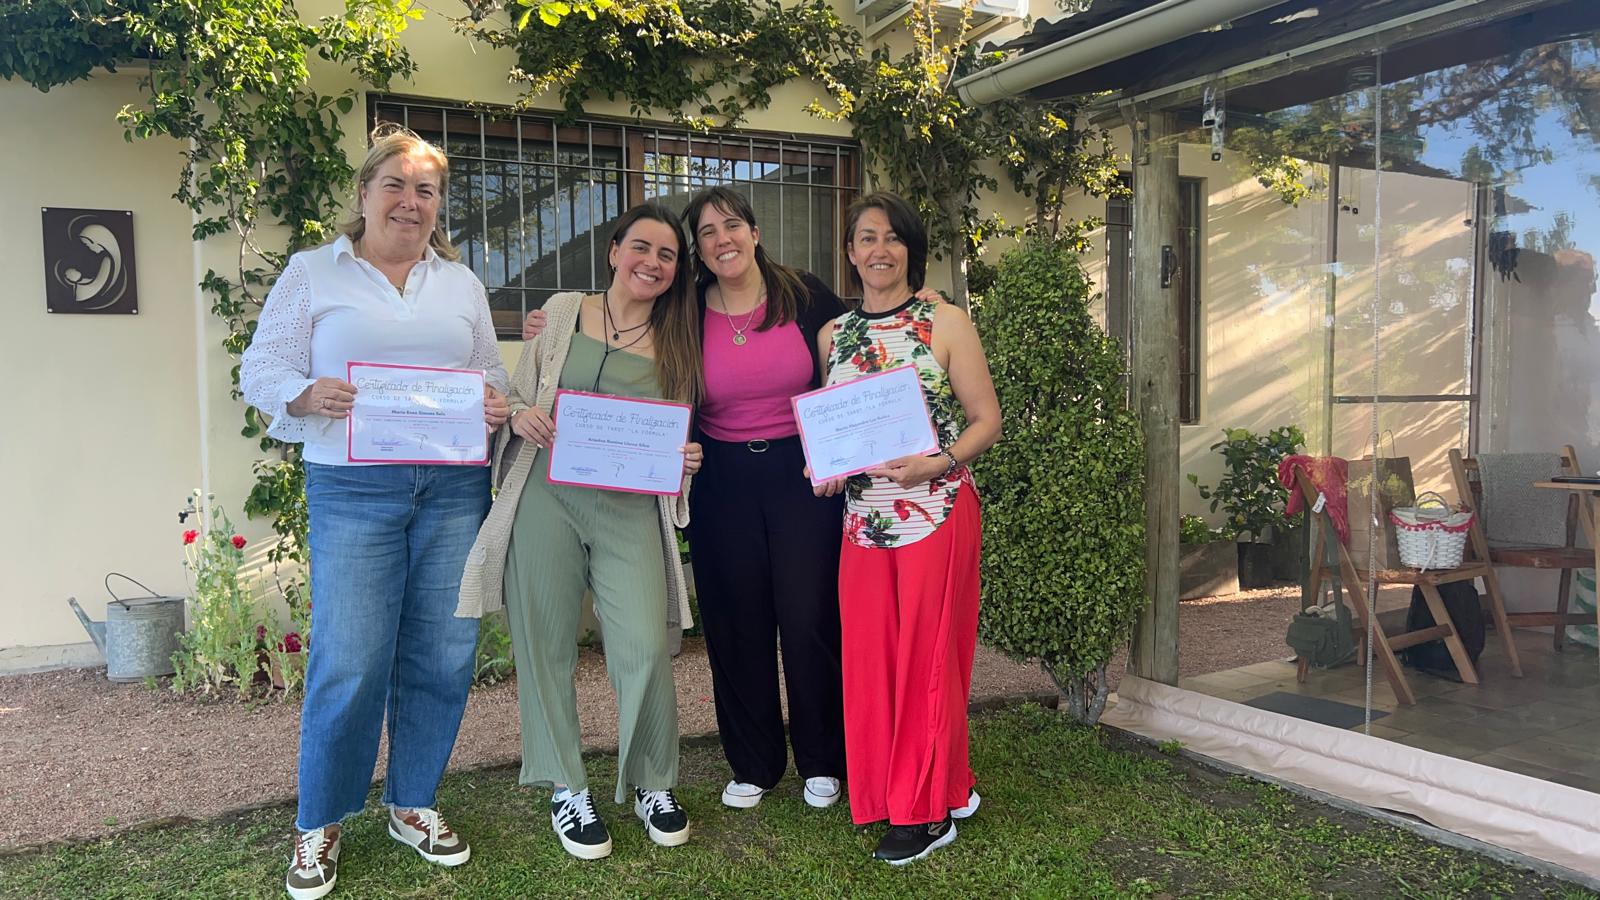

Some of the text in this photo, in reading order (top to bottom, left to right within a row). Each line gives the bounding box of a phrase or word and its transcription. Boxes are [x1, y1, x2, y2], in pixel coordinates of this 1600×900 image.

[357, 377, 408, 394] Certificado
[411, 380, 423, 392] de
[563, 405, 613, 423] Certificado
[616, 411, 627, 423] de
[803, 398, 849, 419] Certificado
[851, 395, 861, 406] de
